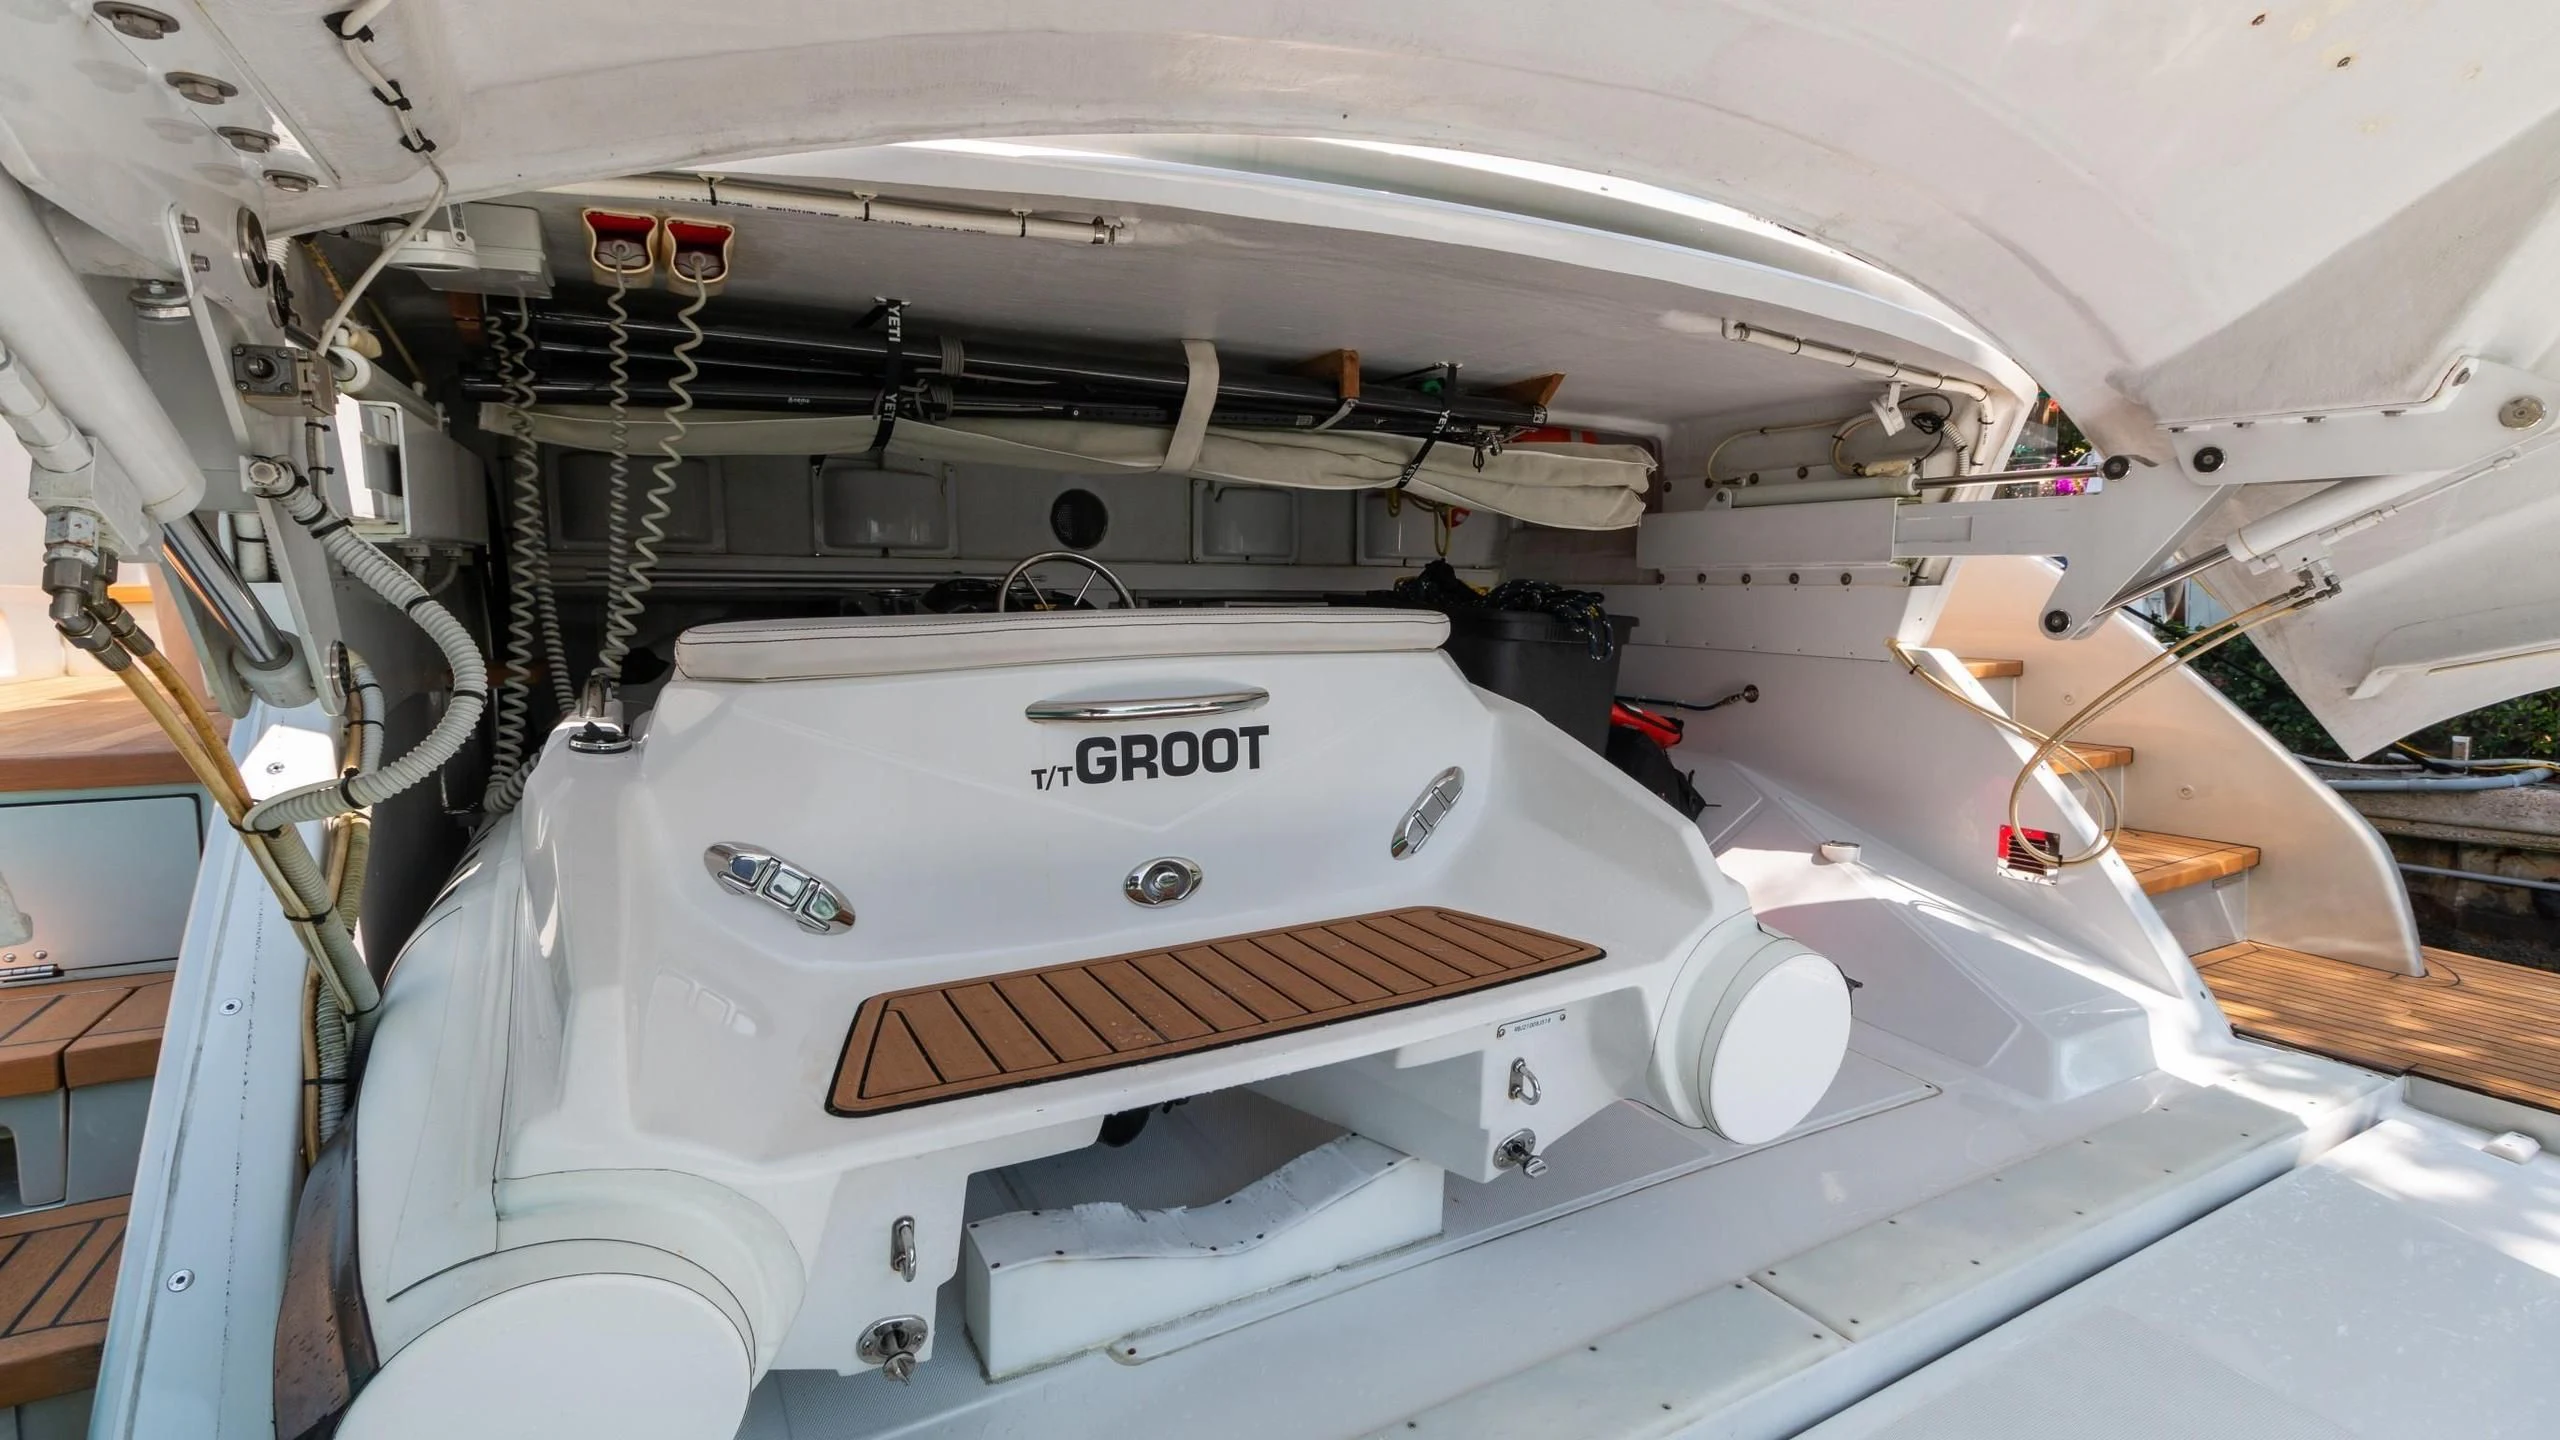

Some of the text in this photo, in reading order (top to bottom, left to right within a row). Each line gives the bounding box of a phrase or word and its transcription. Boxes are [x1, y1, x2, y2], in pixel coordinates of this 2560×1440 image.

[888, 305, 901, 342] YETI
[882, 393, 898, 422] YETI
[1432, 410, 1451, 434] YETI
[1031, 725, 1269, 790] T/T GROOT
